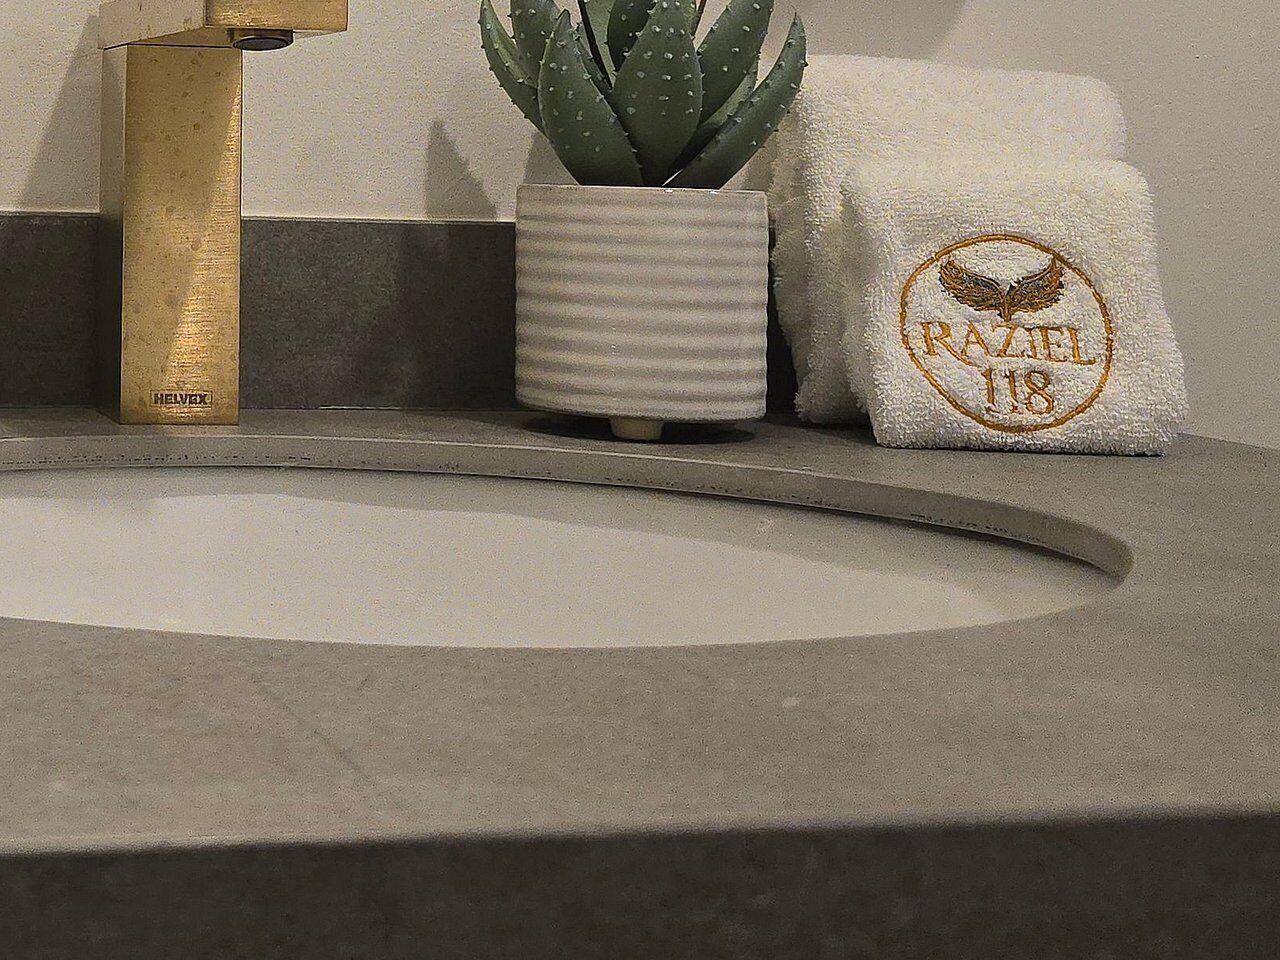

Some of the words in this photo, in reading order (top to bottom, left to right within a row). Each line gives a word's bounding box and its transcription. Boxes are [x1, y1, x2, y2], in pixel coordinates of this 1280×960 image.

[920, 320, 1097, 367] RAZIEL
[154, 393, 208, 405] HELVEX
[981, 366, 1055, 416] 118
